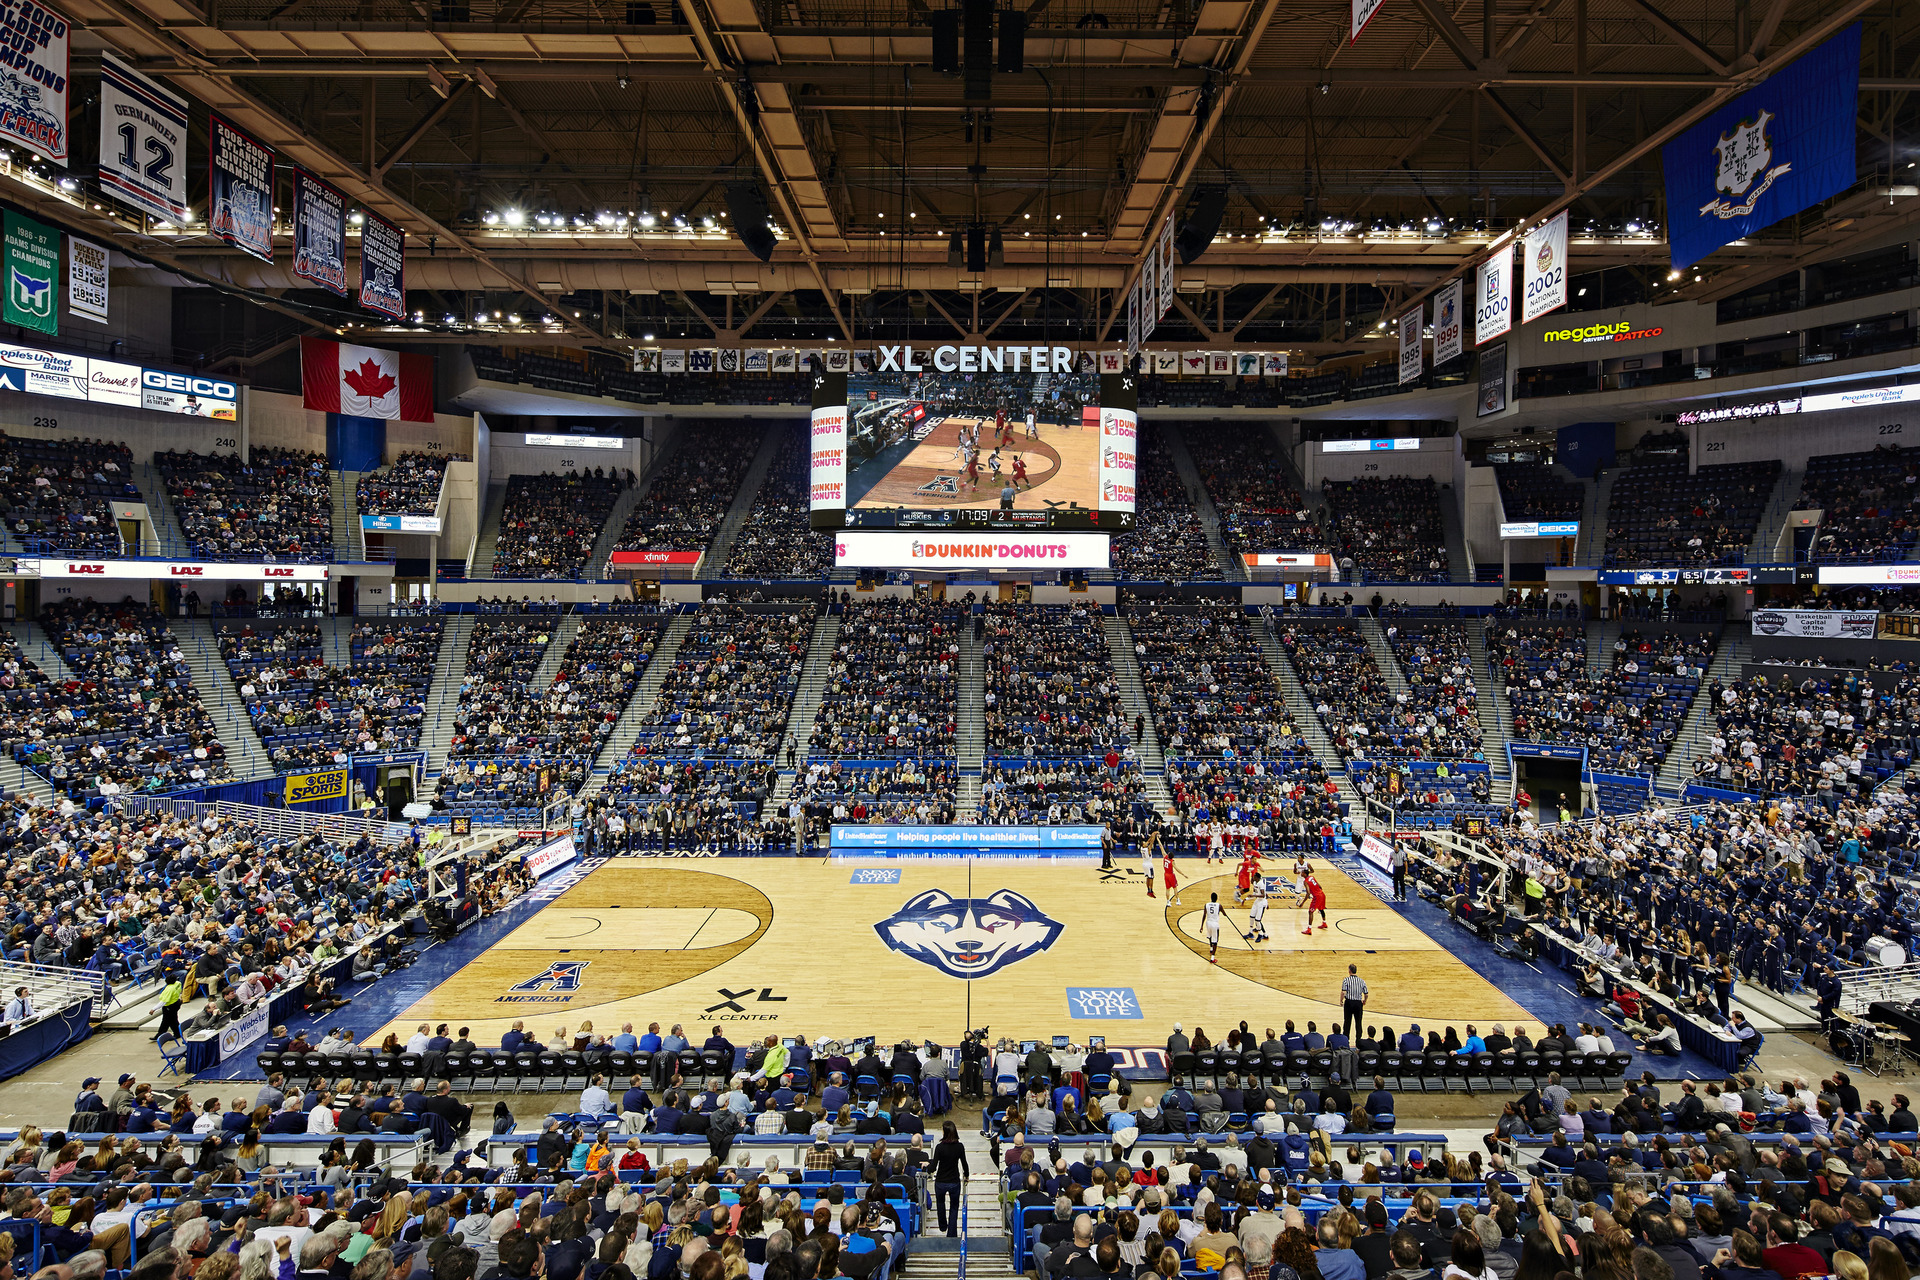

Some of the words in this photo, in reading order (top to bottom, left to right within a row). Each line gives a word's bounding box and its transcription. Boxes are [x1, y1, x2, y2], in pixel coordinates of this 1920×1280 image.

[0, 26, 35, 57] CUP
[15, 116, 59, 150] PACK
[115, 104, 177, 146] GERNANDER
[218, 124, 269, 163] 2008-2009
[118, 122, 173, 190] 12
[220, 138, 267, 172] ATLANTIC
[222, 148, 265, 182] DIVISION
[216, 155, 270, 195] CHAMPIONS
[302, 177, 342, 208] 2003-2004
[303, 190, 339, 218] ATLANTIC
[304, 203, 337, 229] DIVISION
[18, 227, 33, 240] 1986
[39, 236, 47, 244] 87
[299, 213, 341, 243] CHAMPIONS
[368, 217, 401, 243] 2003-2004
[5, 234, 28, 250] ADAMS
[31, 244, 58, 260] DIVISION
[369, 228, 399, 250] EASTERN
[365, 235, 402, 262] CONFERENCE
[12, 249, 51, 269] CHAMPIONS
[365, 245, 401, 271] CHAMPIONS
[1528, 267, 1561, 299] 2002
[1530, 288, 1558, 307] NATIONAL
[1478, 296, 1508, 324] 2000
[1528, 298, 1560, 318] CHAMPIONS
[1481, 317, 1505, 331] NATIONAL
[1544, 322, 1630, 343] megabus
[1437, 325, 1458, 347] 1999
[1479, 325, 1506, 342] CHAMPIONS
[1614, 328, 1663, 343] DATTCO
[34, 354, 72, 366] United
[878, 346, 924, 372] XL
[933, 345, 1072, 373] CENTER
[1401, 345, 1420, 366] 1995
[1436, 348, 1459, 364] CHAMPIONS
[43, 363, 70, 372] Bank
[31, 372, 70, 383] MARCUS
[143, 371, 235, 399] GEICO
[1842, 393, 1874, 403] People's
[1875, 390, 1903, 398] United
[1700, 408, 1733, 421] DARK
[1734, 404, 1776, 417] ROAST
[34, 417, 58, 428] 239
[1879, 424, 1902, 435] 222
[216, 438, 236, 447] 240
[427, 442, 442, 451] 241
[1568, 442, 1578, 450] 220
[1707, 442, 1725, 452] 221
[372, 520, 392, 528] Hilton
[944, 512, 950, 521] 5
[960, 510, 988, 521] 17:09
[998, 512, 1005, 521] 2
[1539, 525, 1578, 533] GEICO
[644, 554, 670, 562] xfinity
[926, 545, 998, 558] DUNKIN'
[998, 545, 1067, 558] DONUTS
[69, 564, 104, 574] LAZ
[171, 566, 203, 575] LAZ
[264, 568, 294, 577] LAZ
[1662, 571, 1670, 579] 5
[1714, 571, 1722, 580] 2
[317, 772, 343, 784] CBS
[290, 782, 342, 800] SPORTS
[845, 832, 888, 840] UnitedHealthcare
[897, 833, 930, 842] Helping
[932, 834, 960, 842] people
[963, 833, 978, 841] live
[980, 833, 1018, 841] healthier
[1020, 833, 1041, 841] lives.
[1364, 837, 1379, 853] BOB'S
[530, 852, 550, 868] BOB'S
[615, 850, 722, 858] UCONN
[529, 857, 608, 901] HUSKIES
[457, 913, 478, 932] TRAVELERS
[1457, 916, 1478, 933] TRAVELERS
[704, 988, 788, 1013] XL
[1071, 998, 1136, 1008] YORK
[1079, 991, 1125, 1000] NEW
[1083, 1006, 1132, 1016] LIFE
[240, 1011, 268, 1032] Webster
[241, 1026, 259, 1042] Bank
